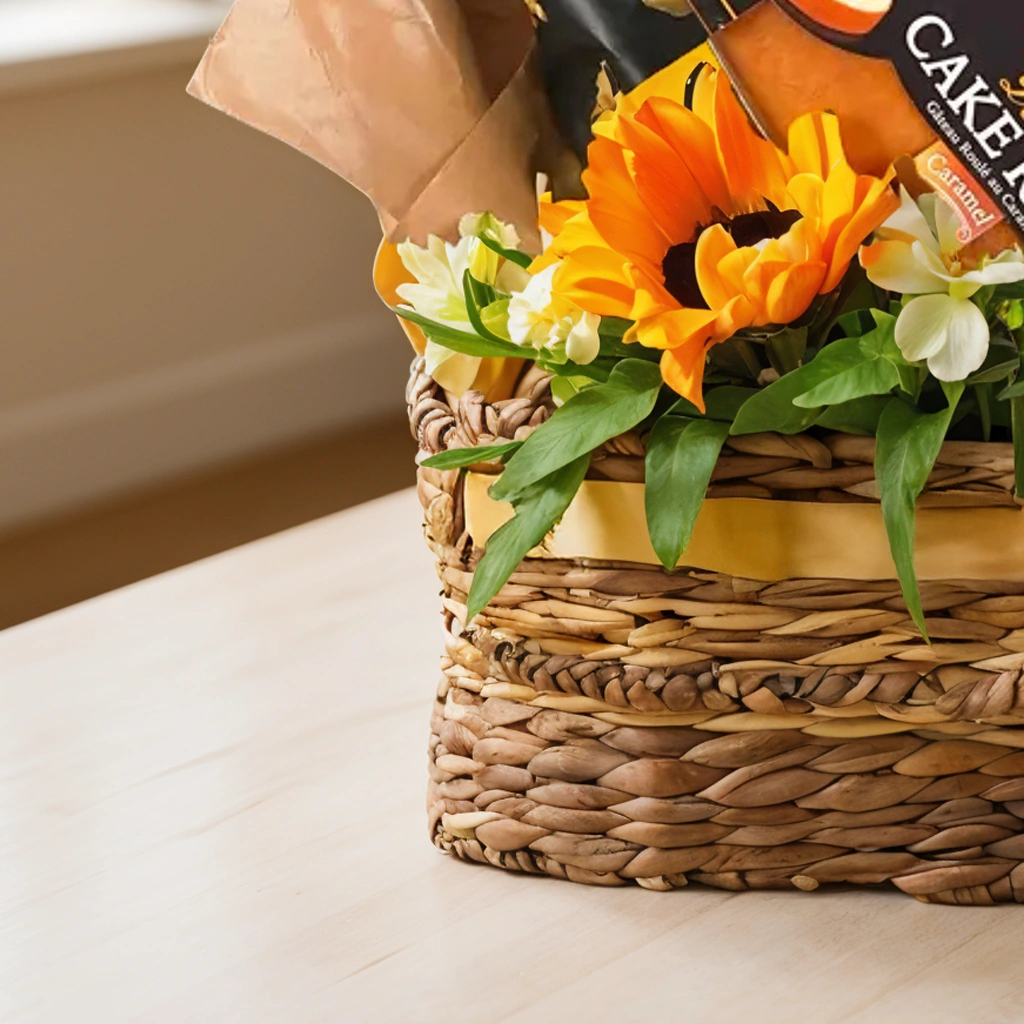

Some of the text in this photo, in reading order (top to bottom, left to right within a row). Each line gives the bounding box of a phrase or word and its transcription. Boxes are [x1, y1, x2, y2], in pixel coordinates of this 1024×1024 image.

[906, 14, 1024, 160] CAKE
[926, 99, 960, 145] Gâteau
[959, 141, 991, 178] Roulé
[988, 177, 1003, 195] au
[926, 152, 996, 228] Caramel
